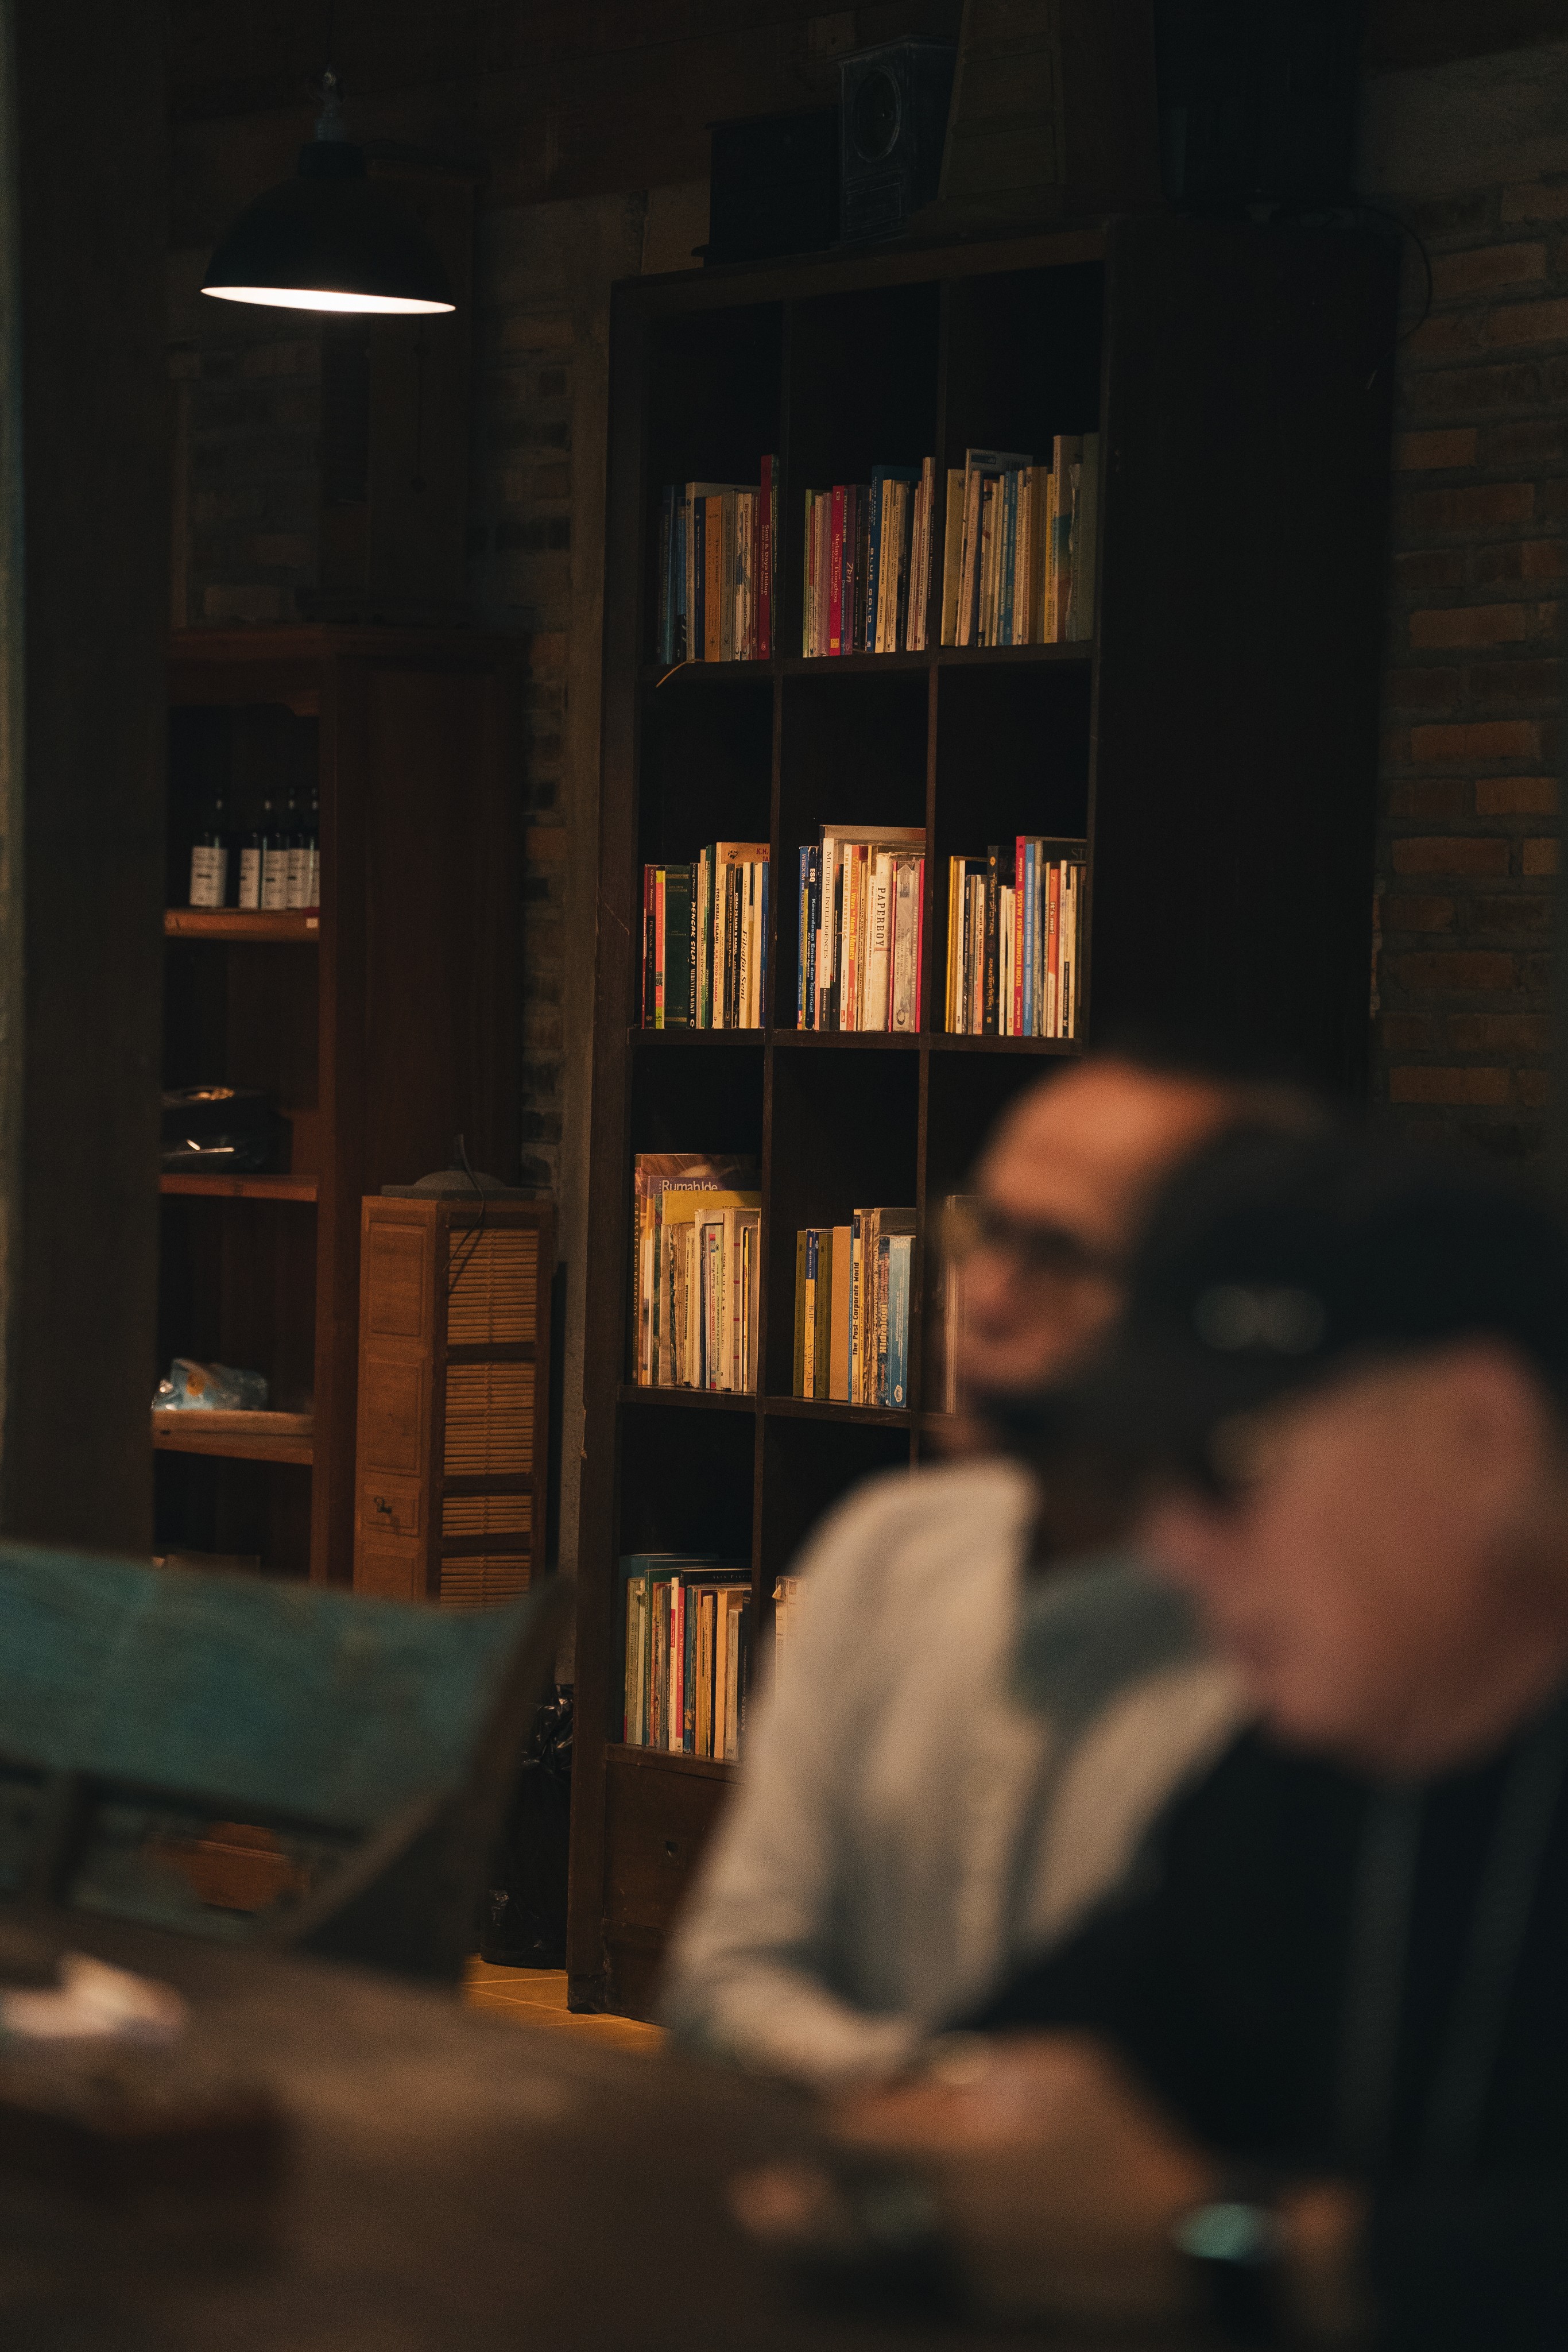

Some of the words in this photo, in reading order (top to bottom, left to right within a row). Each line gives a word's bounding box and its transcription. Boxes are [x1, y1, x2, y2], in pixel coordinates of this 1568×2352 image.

[846, 562, 854, 583] Zen
[876, 887, 886, 946] PAPERBOY
[879, 1305, 888, 1353] Hidrologi
